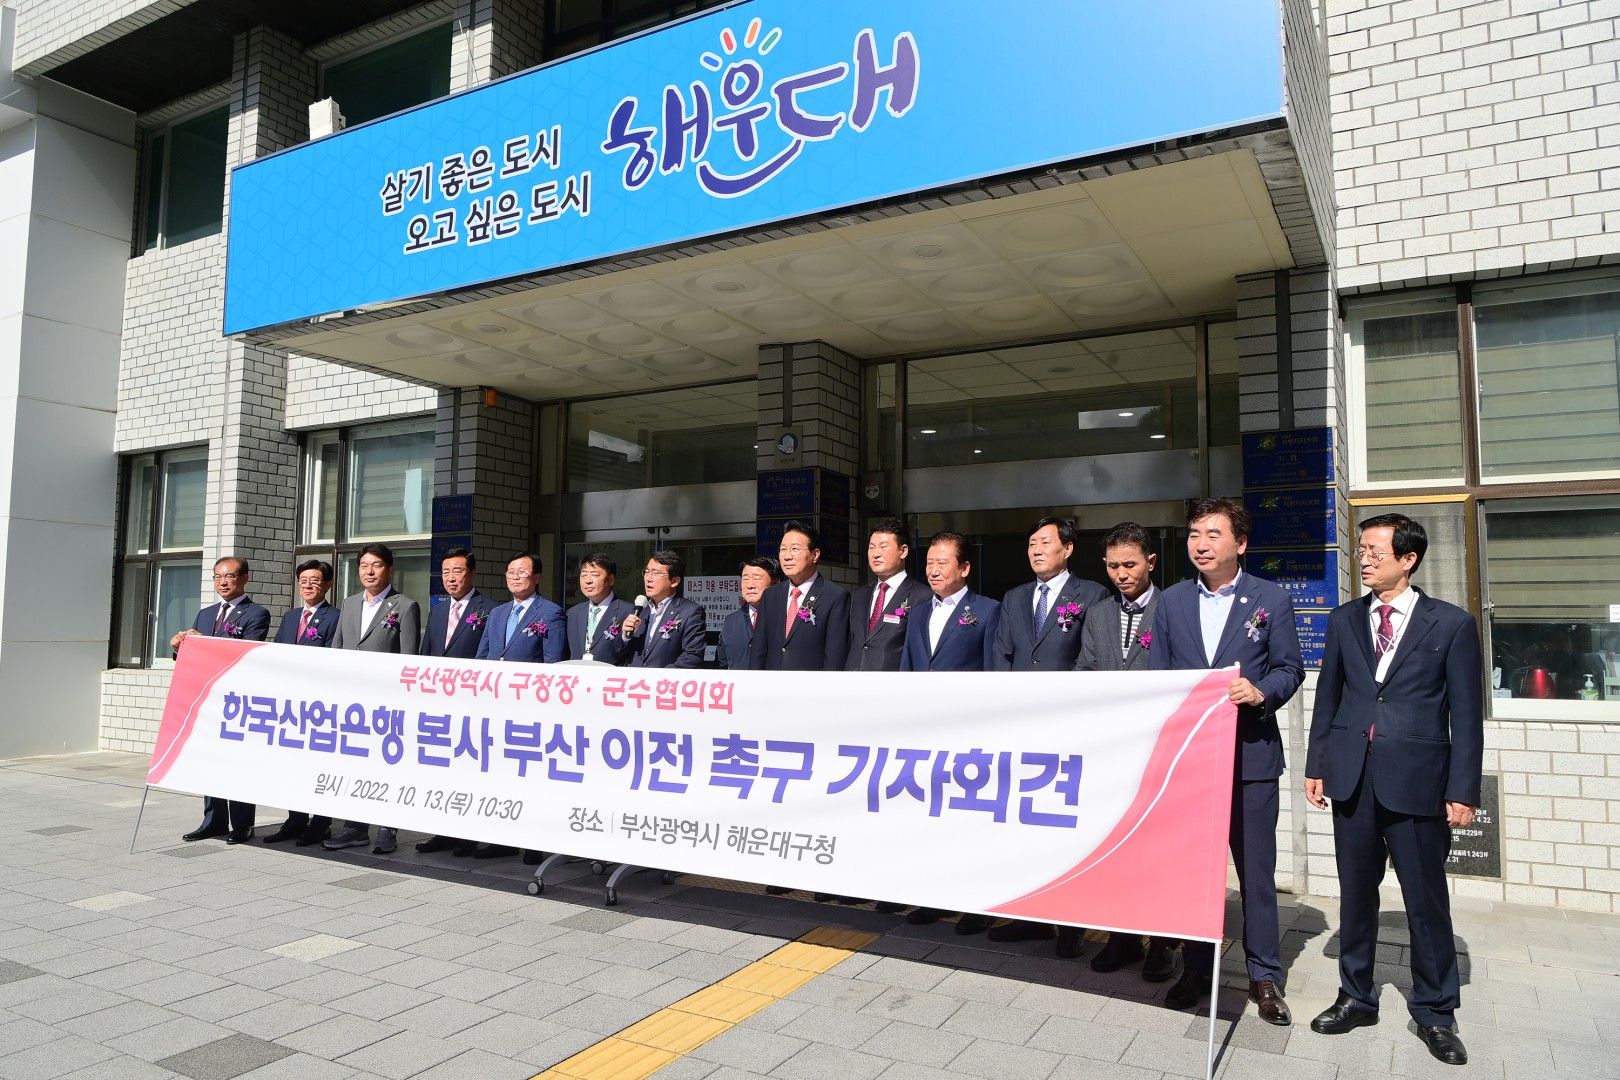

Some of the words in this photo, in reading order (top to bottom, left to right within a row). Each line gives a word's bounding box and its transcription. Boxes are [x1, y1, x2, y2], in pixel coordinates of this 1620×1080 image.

[603, 29, 921, 194] 해운대
[383, 166, 431, 213] 살기
[440, 149, 493, 197] 좋은
[502, 128, 559, 176] 도시
[405, 211, 456, 251] 오고
[466, 194, 520, 243] 싶은
[530, 175, 589, 222] 도시
[688, 580, 703, 592] 마스크
[706, 580, 715, 592] 착용
[399, 666, 503, 699] 부산광역시
[508, 672, 579, 705] 구청장
[602, 677, 735, 715] 군수협의회
[220, 691, 405, 765] 한국산업은행
[417, 711, 494, 773] 본사
[503, 719, 590, 784] 부산
[601, 728, 693, 794] 이전
[709, 733, 815, 804] 촉구
[826, 744, 1083, 829] 기자회견
[314, 773, 344, 797] 일시
[350, 779, 391, 803] 2022.
[396, 786, 418, 807] 10.
[424, 789, 474, 817] 13.(목)
[477, 796, 523, 821] 10:30
[568, 807, 604, 833] 장소
[620, 812, 720, 850] 부산광역시
[727, 825, 837, 865] 해운대구청
